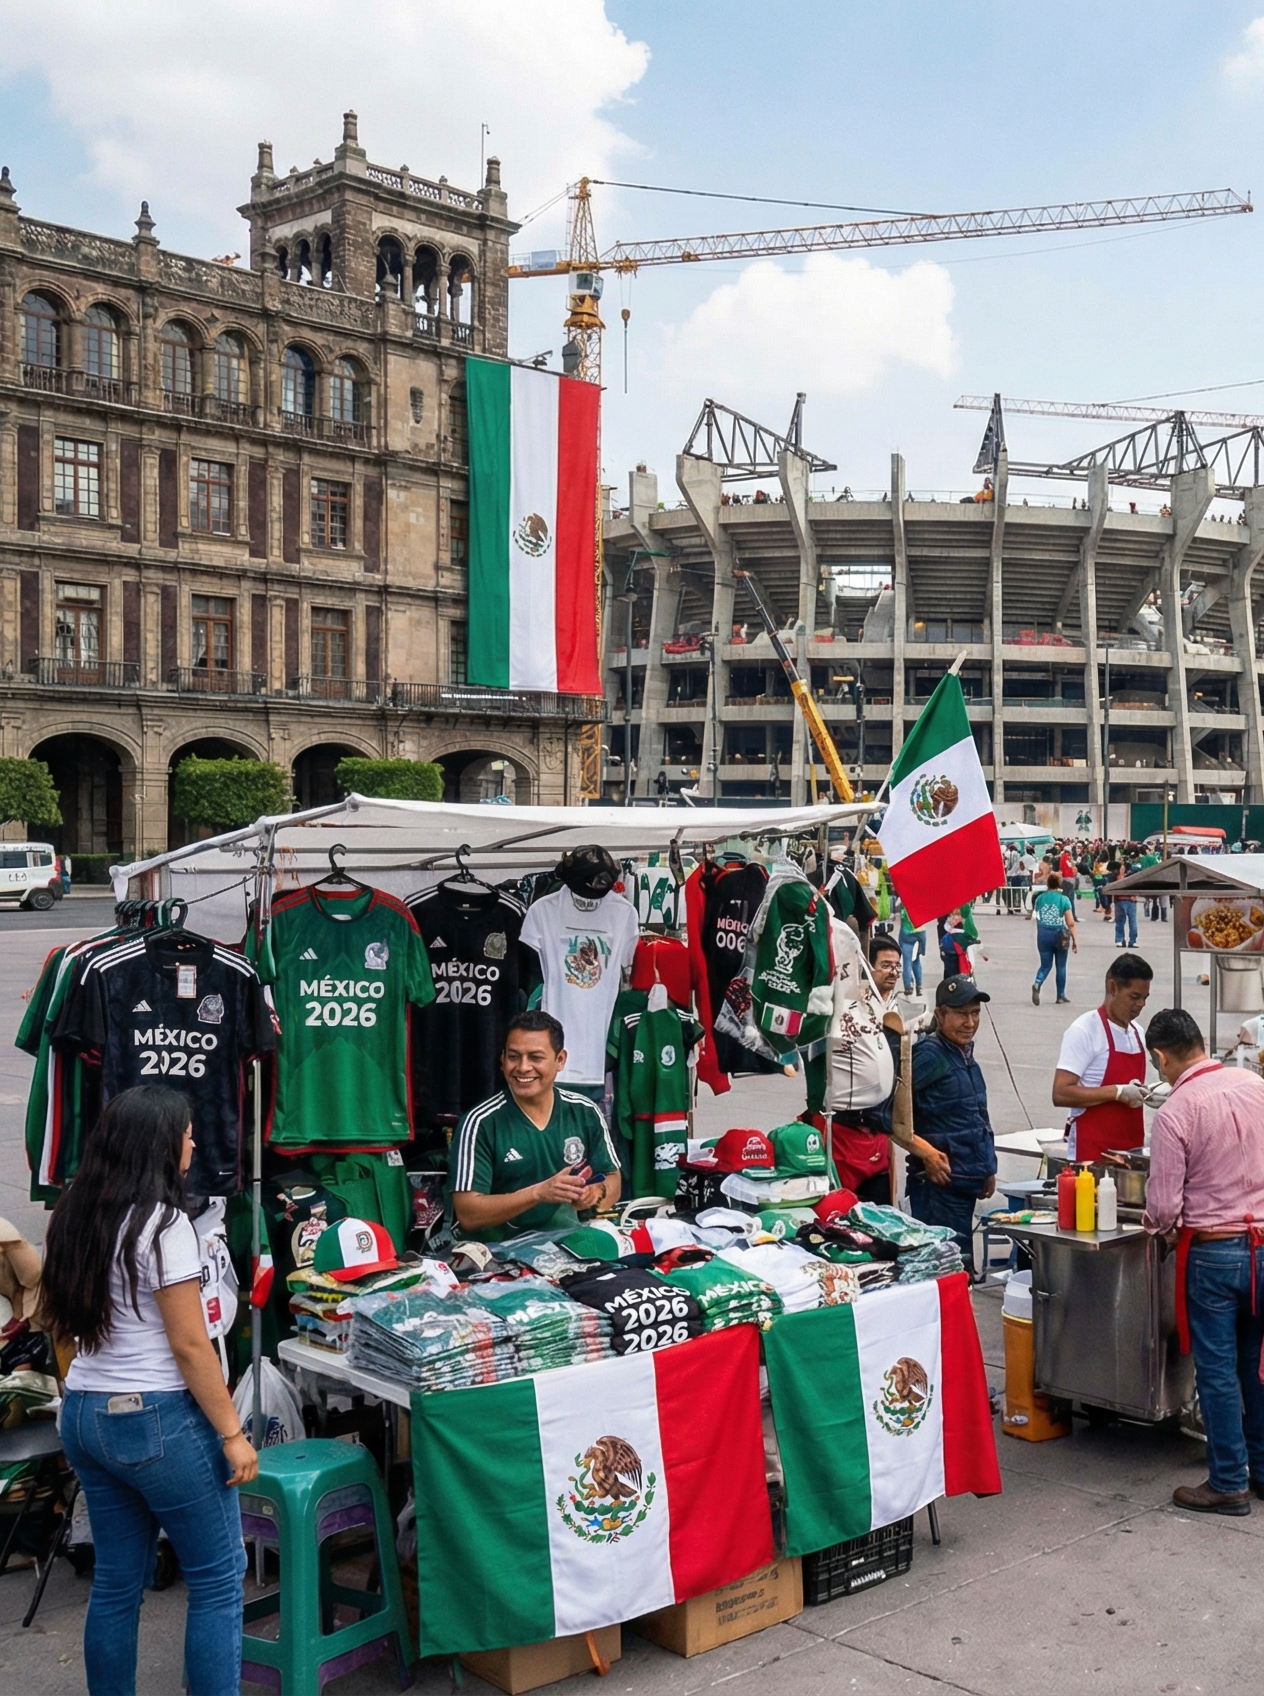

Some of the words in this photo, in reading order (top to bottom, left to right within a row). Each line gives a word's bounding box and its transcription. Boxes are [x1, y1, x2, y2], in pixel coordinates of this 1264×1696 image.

[431, 957, 500, 981] MÉXICO
[299, 974, 385, 999] MÉXICO
[435, 981, 492, 1006] 2026
[305, 1000, 377, 1028] 2026
[133, 1023, 218, 1051] MÉXICO
[604, 1286, 691, 1313] MÉXICO
[621, 1296, 689, 1331] 2026
[622, 1321, 689, 1355] 2026
